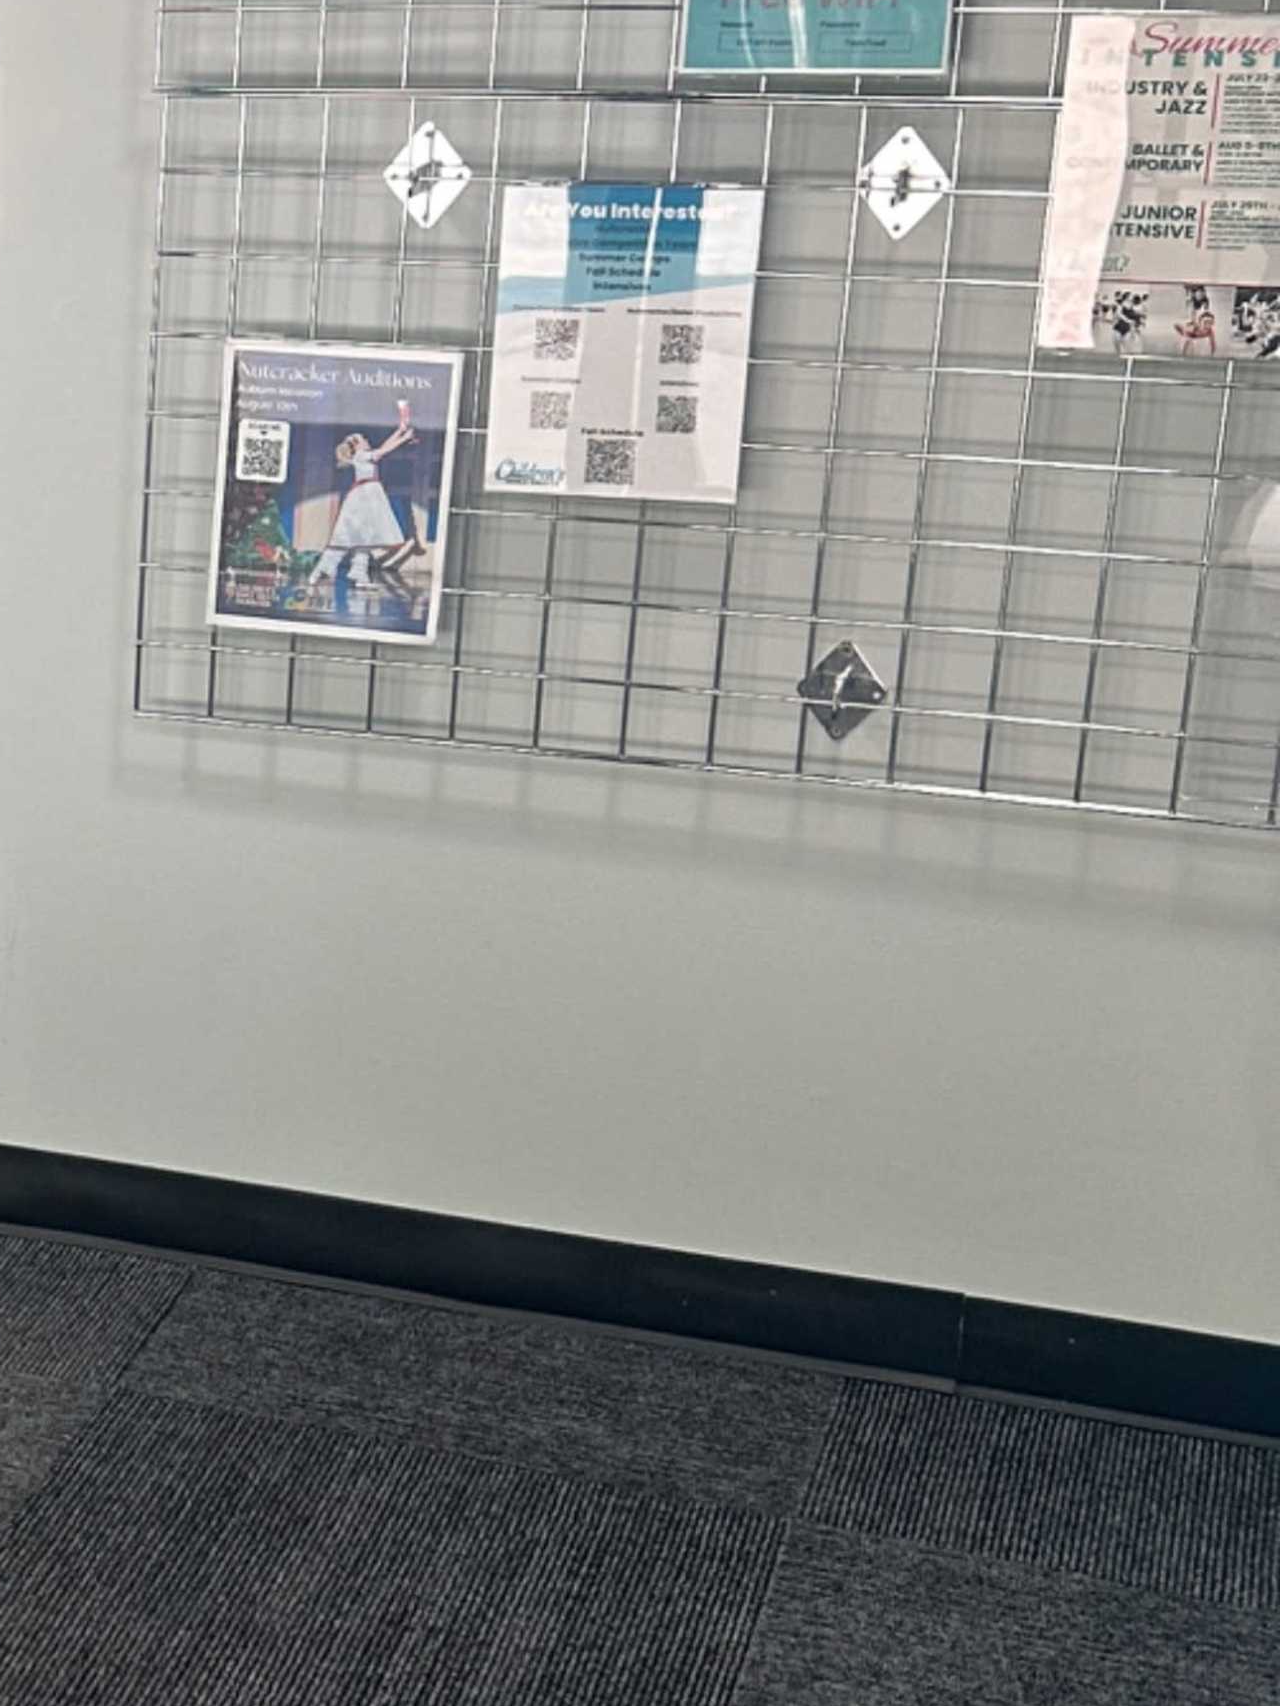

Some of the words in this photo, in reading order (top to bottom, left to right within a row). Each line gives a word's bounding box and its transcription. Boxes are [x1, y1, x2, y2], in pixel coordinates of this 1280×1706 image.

[1192, 80, 1208, 96] &
[1154, 100, 1208, 115] JAZZ
[1132, 143, 1189, 157] BALLET
[567, 201, 607, 219] You
[1121, 204, 1197, 221] JUNIOR
[1109, 223, 1195, 239] TENSIVE
[239, 360, 339, 384] Nutcracker
[345, 367, 433, 390] Auditions
